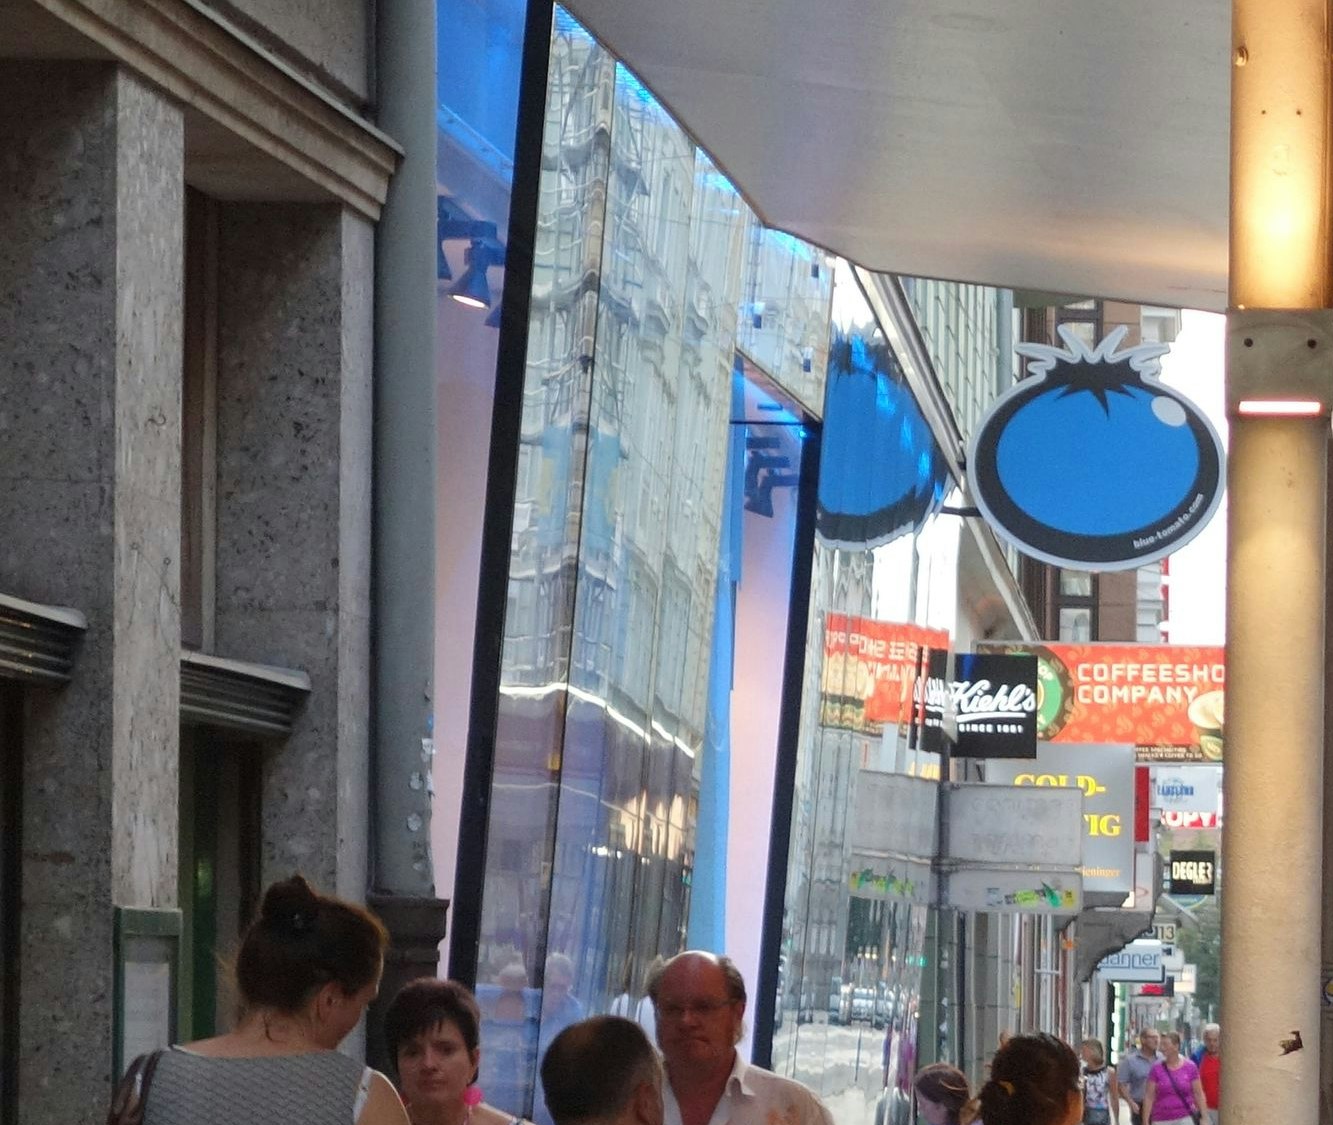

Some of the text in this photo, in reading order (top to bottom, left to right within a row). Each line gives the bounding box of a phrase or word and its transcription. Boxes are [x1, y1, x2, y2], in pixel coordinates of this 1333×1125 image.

[1133, 492, 1204, 549] blue-tomato.com
[1077, 663, 1225, 682] COFFEESHO
[952, 679, 1036, 713] Kiehl's
[1077, 685, 1199, 704] COMPANY
